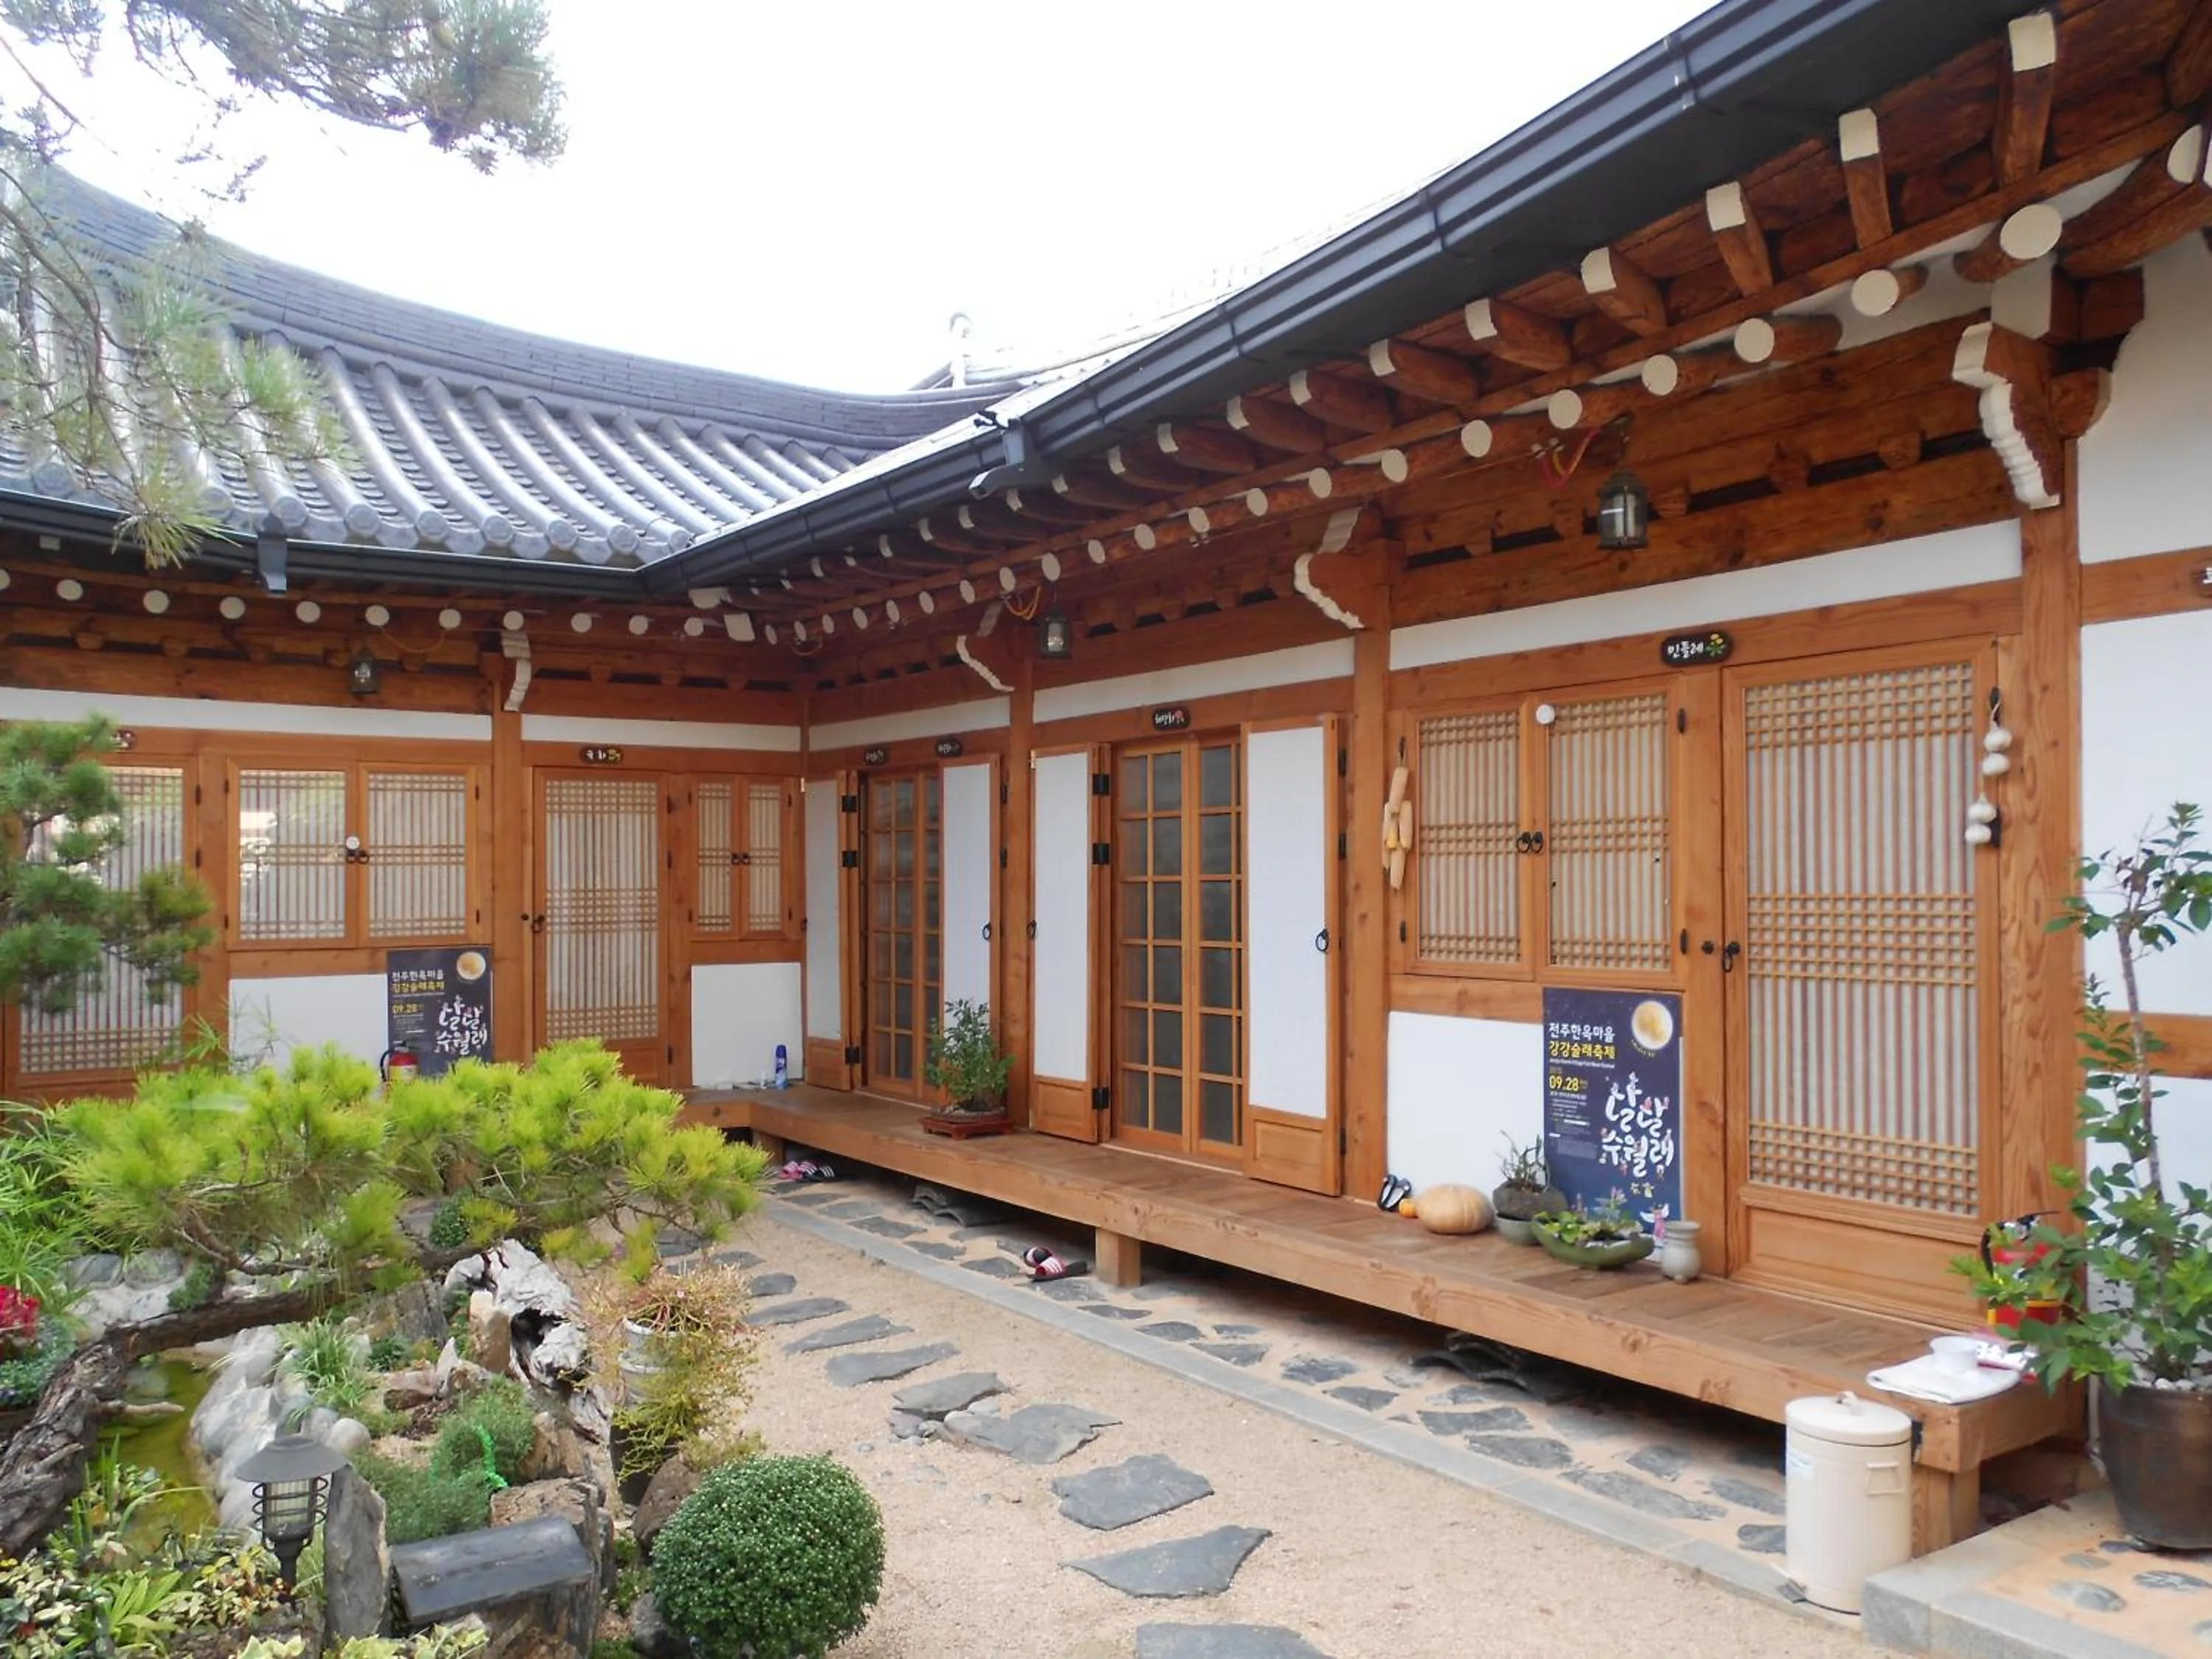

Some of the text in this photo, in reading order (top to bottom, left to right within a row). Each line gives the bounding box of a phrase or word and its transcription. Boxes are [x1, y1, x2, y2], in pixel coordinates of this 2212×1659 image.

[1549, 1022, 1616, 1043] 전주한옥마을
[1549, 1040, 1615, 1060] 강강술래축제
[1549, 1074, 1579, 1091] 09.28
